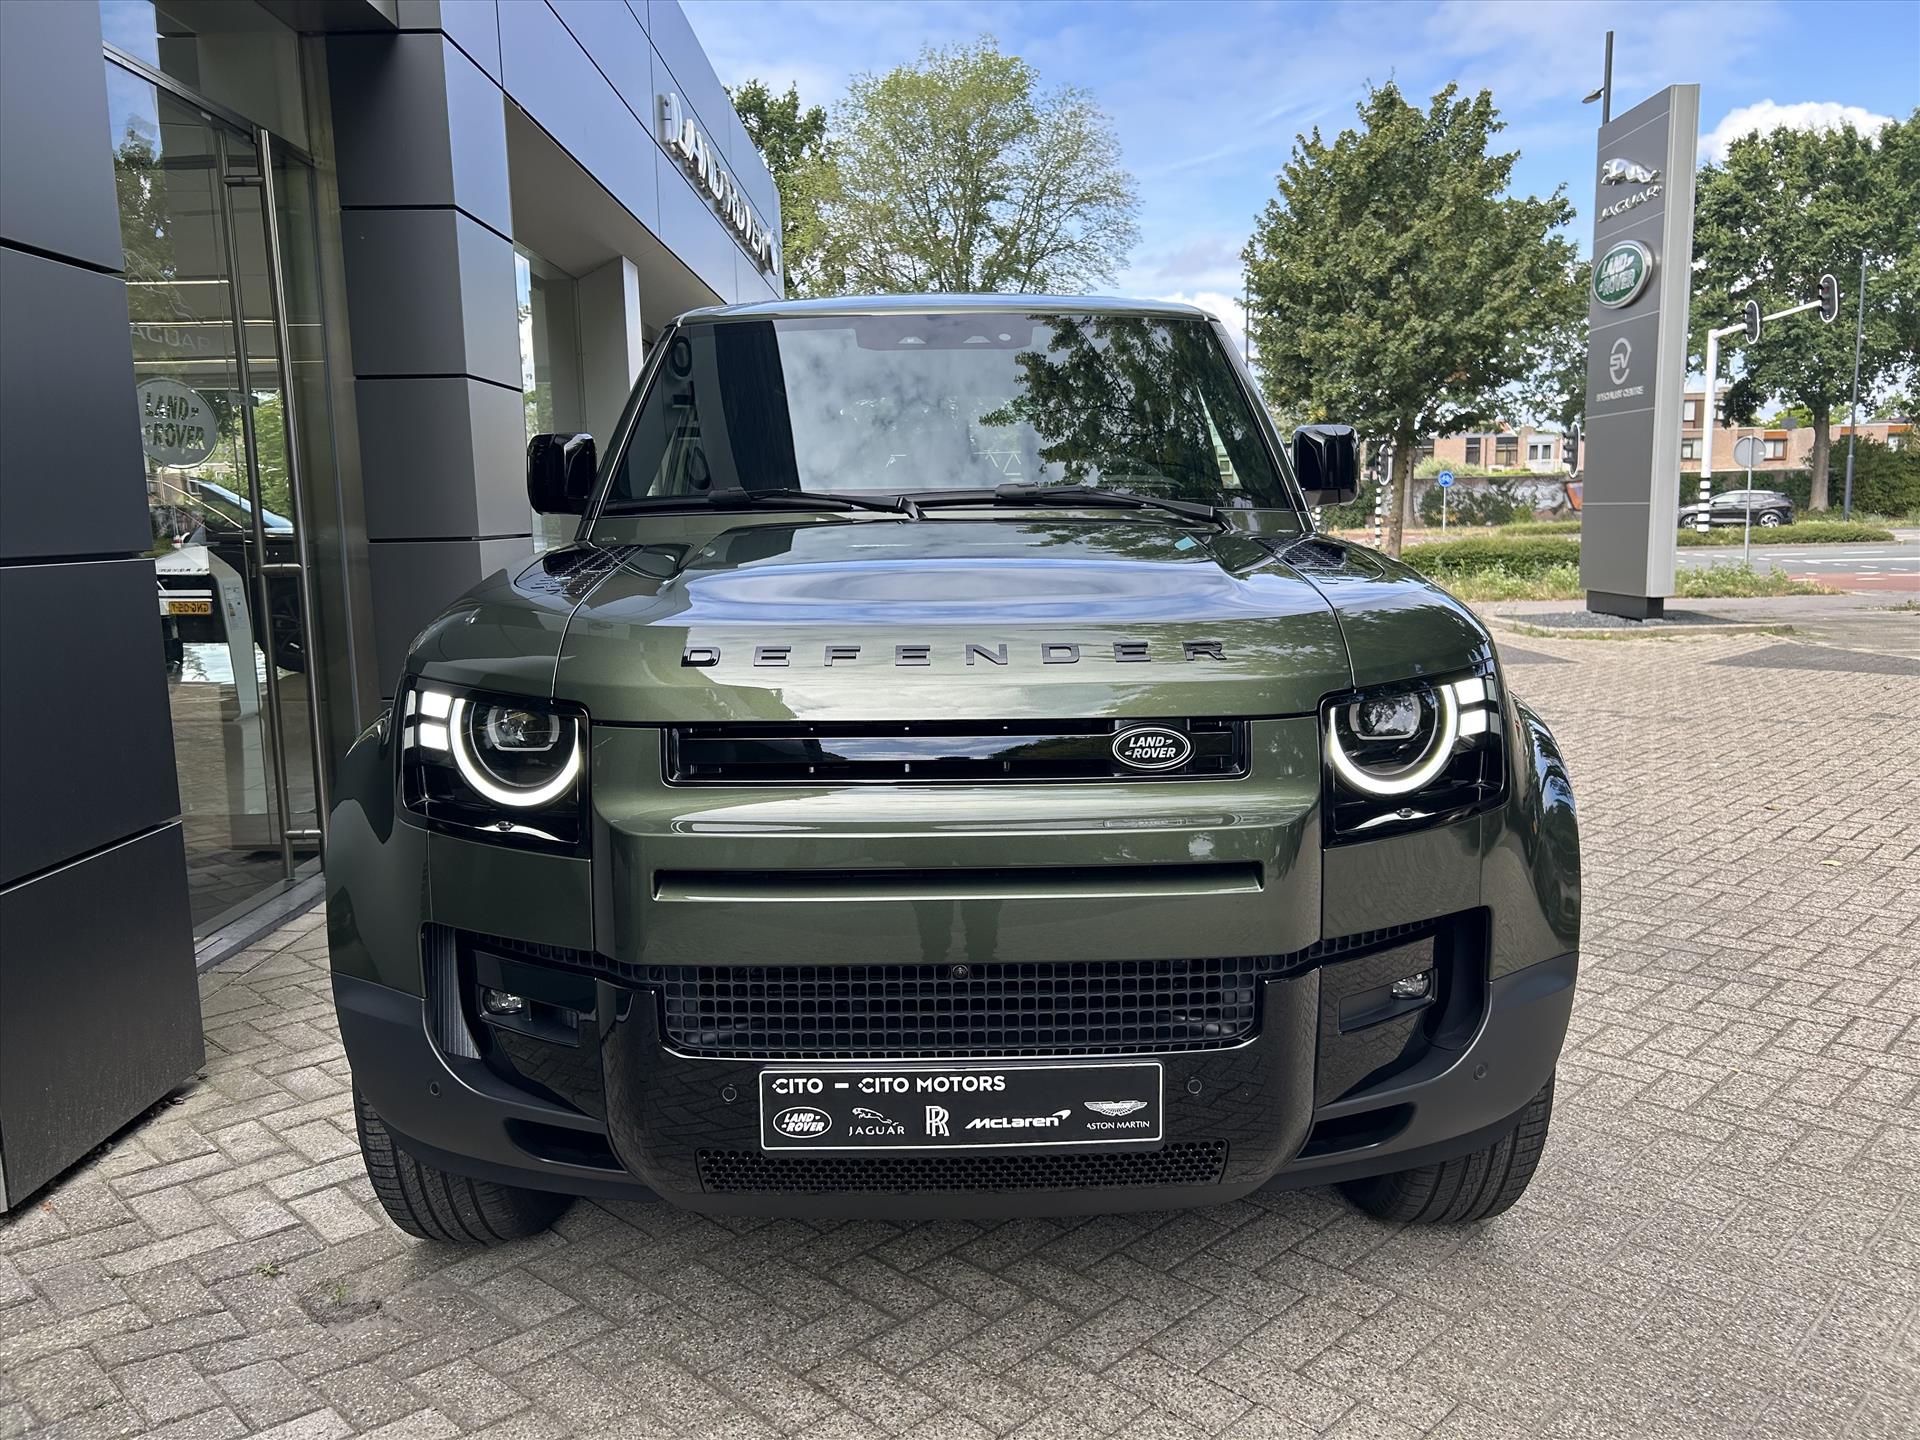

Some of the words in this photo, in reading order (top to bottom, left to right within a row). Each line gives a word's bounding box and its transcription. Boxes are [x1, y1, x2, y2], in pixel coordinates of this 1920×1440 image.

[1598, 185, 1660, 223] JAGUAR
[1601, 253, 1630, 279] LAND
[1602, 268, 1635, 296] ROVER
[130, 322, 211, 352] AGUAR
[681, 641, 1228, 668] DEFENDER
[1129, 736, 1165, 748] LAND
[1132, 747, 1176, 759] ROVER
[772, 1078, 824, 1094] CITO
[858, 1077, 910, 1094] CITO
[916, 1075, 1006, 1093] MOTORS
[784, 1113, 815, 1123] LAND
[964, 1116, 1060, 1130] McLaren
[1086, 1121, 1115, 1130] ASTON
[1116, 1120, 1151, 1129] MARTIN
[785, 1122, 825, 1132] ROVER
[848, 1125, 905, 1137] JAGUAR
